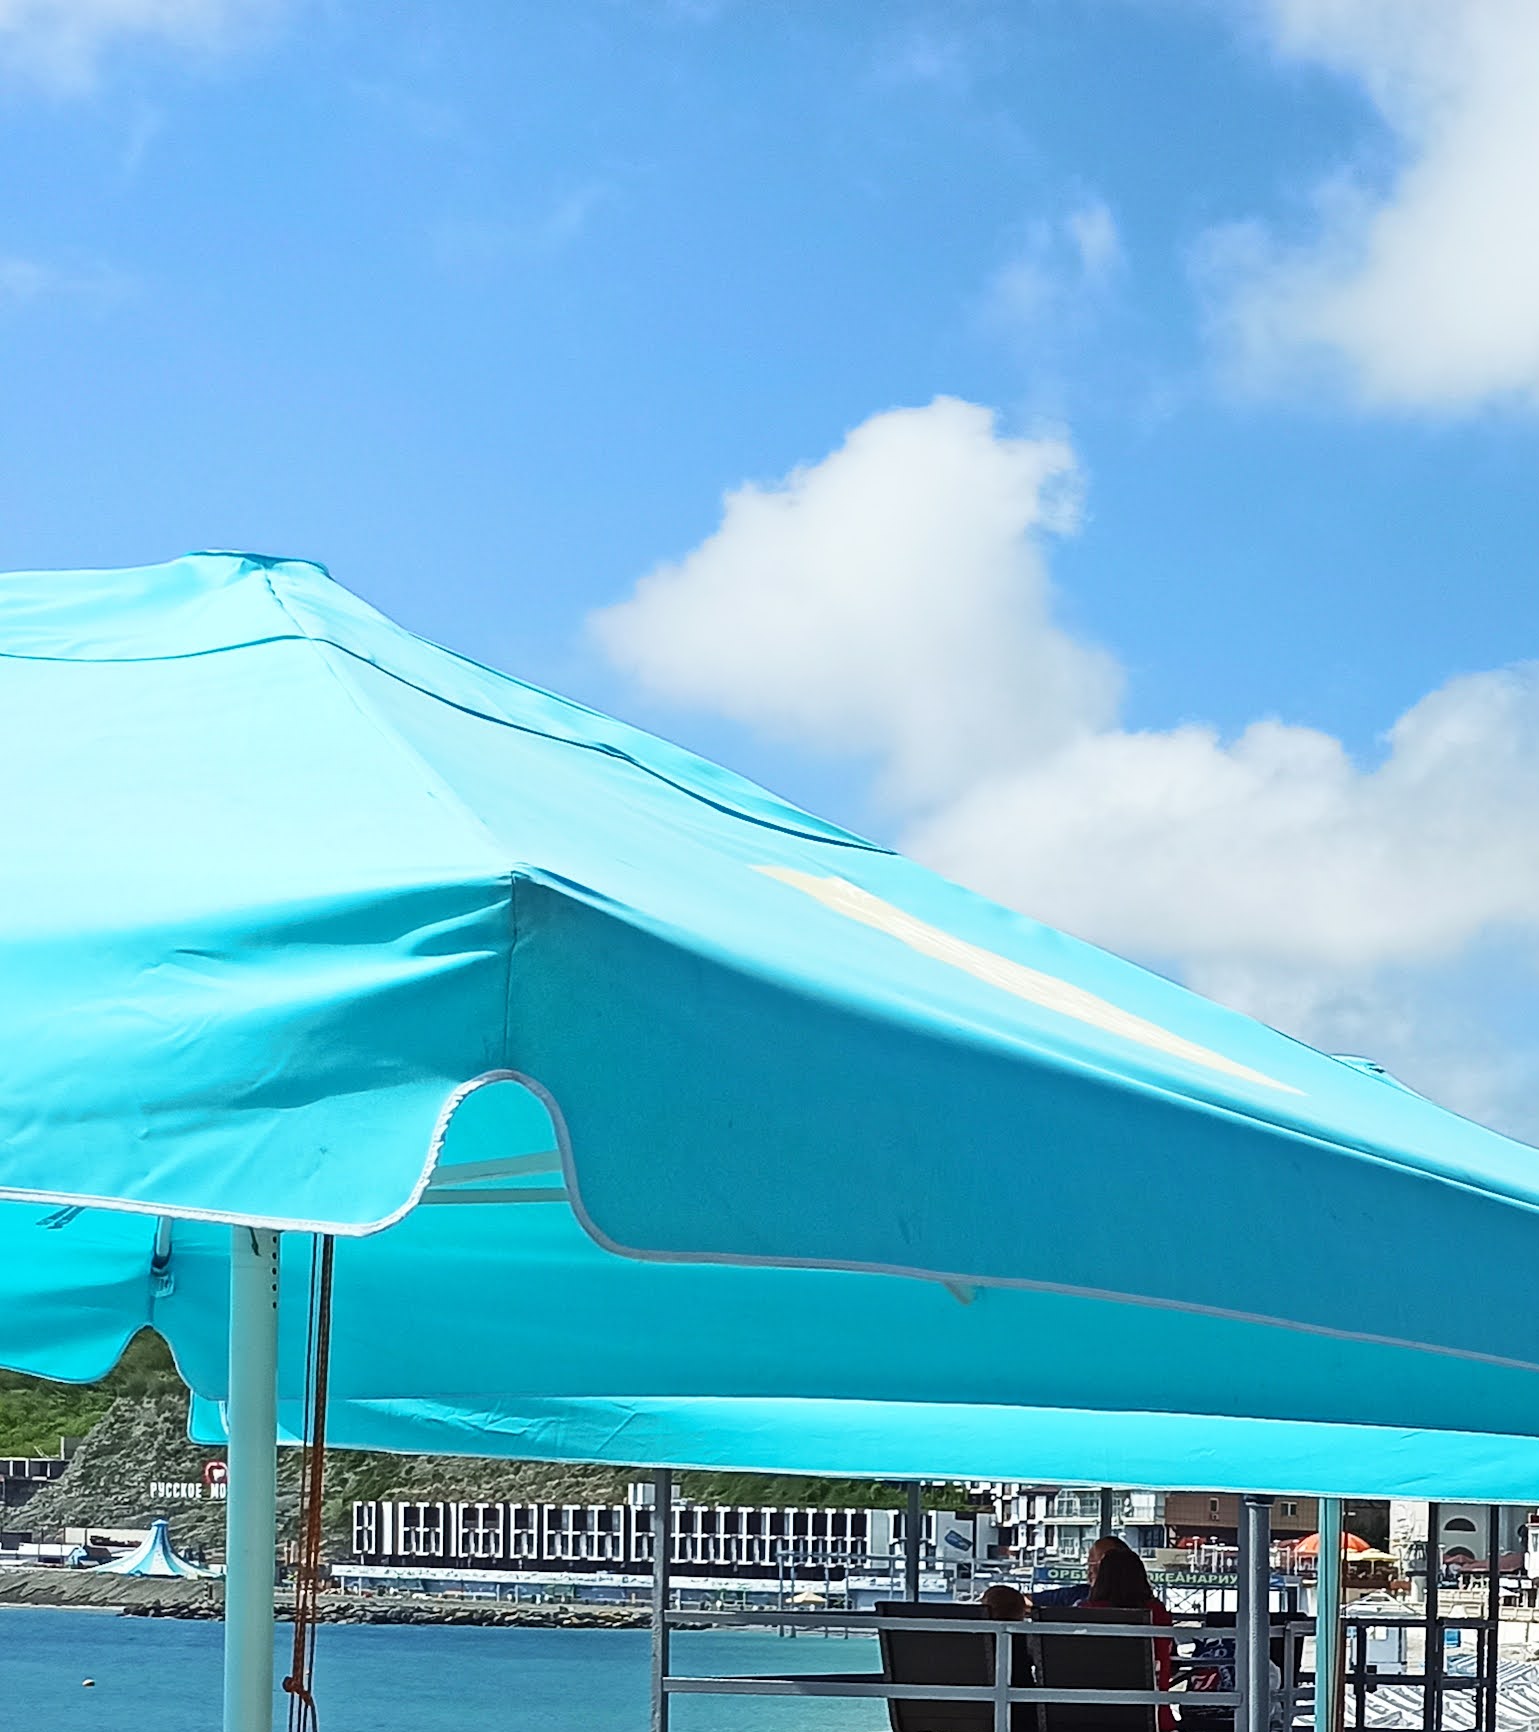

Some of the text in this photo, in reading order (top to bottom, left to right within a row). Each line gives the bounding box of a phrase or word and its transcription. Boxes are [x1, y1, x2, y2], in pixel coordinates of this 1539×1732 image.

[150, 1481, 202, 1499] РУССКОЕ
[1047, 1568, 1238, 1584] ОРБИ КЕАНАРИУ
